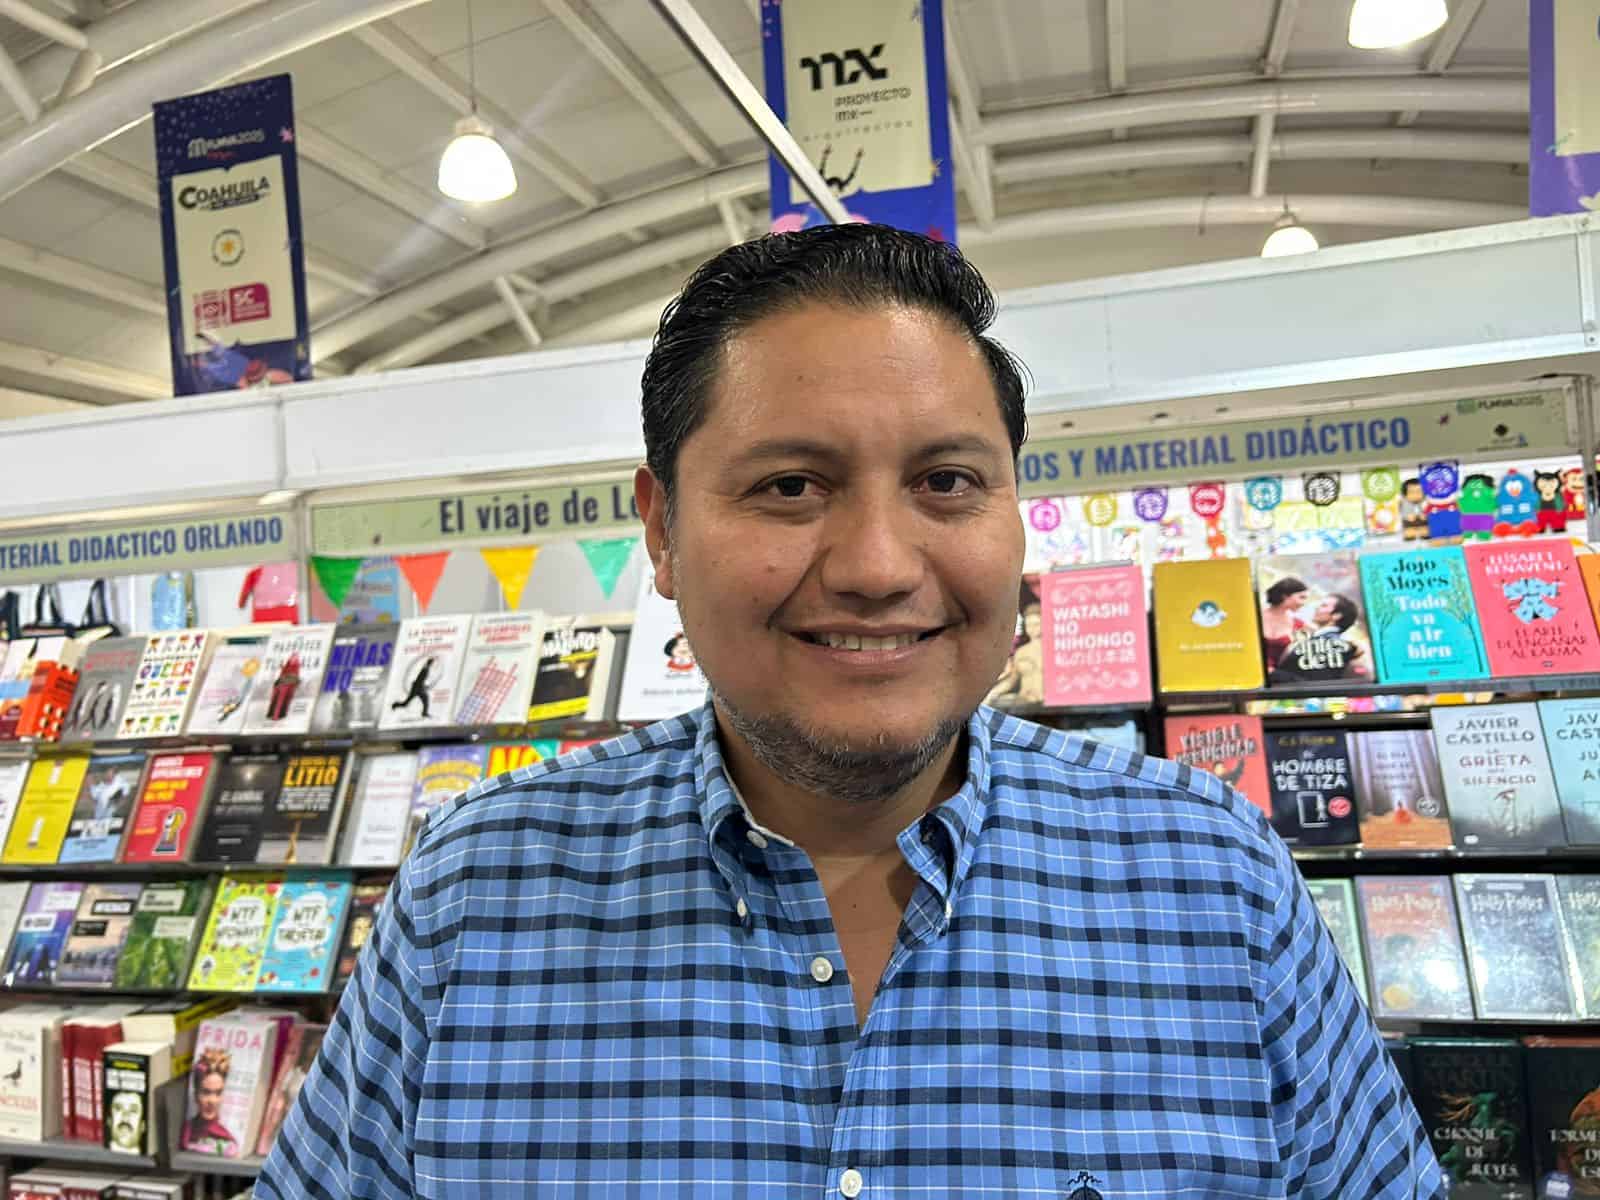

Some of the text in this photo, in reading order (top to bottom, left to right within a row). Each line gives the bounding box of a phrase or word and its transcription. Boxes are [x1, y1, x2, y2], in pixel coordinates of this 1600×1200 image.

[834, 87, 911, 107] PROYECTO
[179, 175, 269, 209] COAHUILA
[1017, 414, 1411, 483] OS Y MATERIAL DIDÁCTICO
[440, 499, 465, 533] El
[477, 495, 550, 534] viaje
[563, 489, 599, 525] de
[69, 529, 177, 564] DIDACTICO
[184, 517, 283, 553] ORLANDO
[1393, 558, 1436, 575] Jojo
[1387, 576, 1449, 592] Moyes
[1052, 602, 1130, 620] WATASHI
[1394, 593, 1448, 612] Todo
[1053, 623, 1079, 636] NO
[1054, 631, 1136, 651] NIHONGO
[331, 636, 393, 667] NIÑAS
[1408, 643, 1452, 660] bien
[324, 668, 354, 692] NO
[1456, 716, 1519, 730] JAVIER
[1446, 730, 1535, 745] CASTILLO
[1272, 758, 1347, 775] HOMBRE
[1459, 754, 1532, 768] GRIETA
[283, 765, 339, 786] LITIO
[1275, 773, 1348, 791] DE TIZA
[1462, 775, 1537, 785] SILENCIO
[199, 1024, 262, 1049] FRIDA
[1433, 1127, 1498, 1144] CHOQUE
[1465, 1146, 1484, 1159] DE
[1470, 1163, 1519, 1178] REYES
